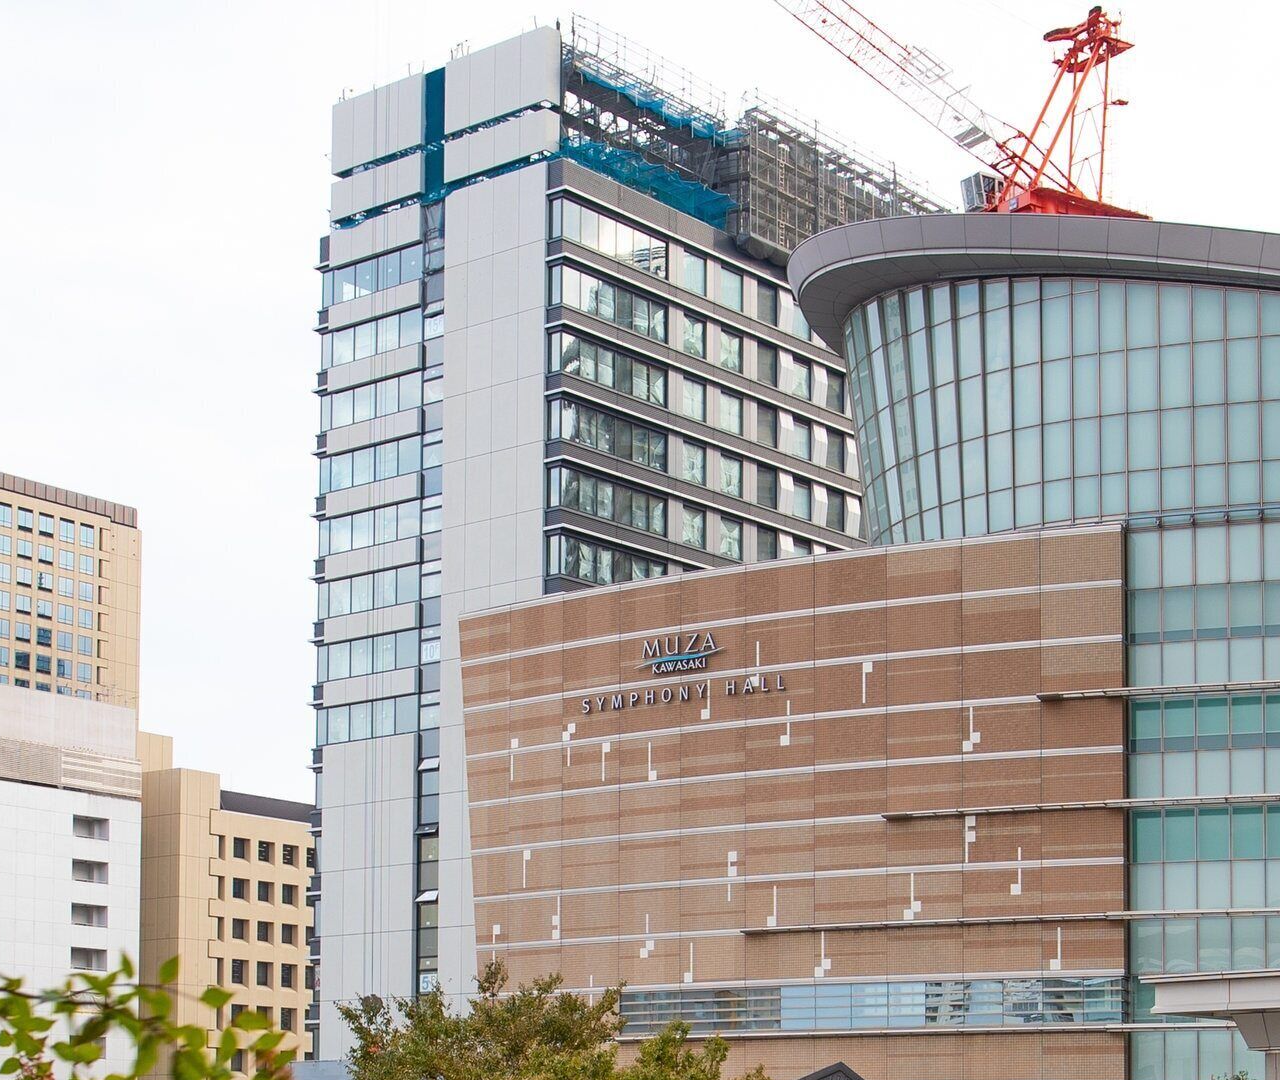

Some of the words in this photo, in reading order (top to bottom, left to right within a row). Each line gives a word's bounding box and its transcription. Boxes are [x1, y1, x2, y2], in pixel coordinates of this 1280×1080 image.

[642, 632, 716, 658] MUZA
[652, 658, 706, 674] KAWASAKI
[582, 684, 707, 714] SYMPHONY
[725, 675, 785, 695] HALL
